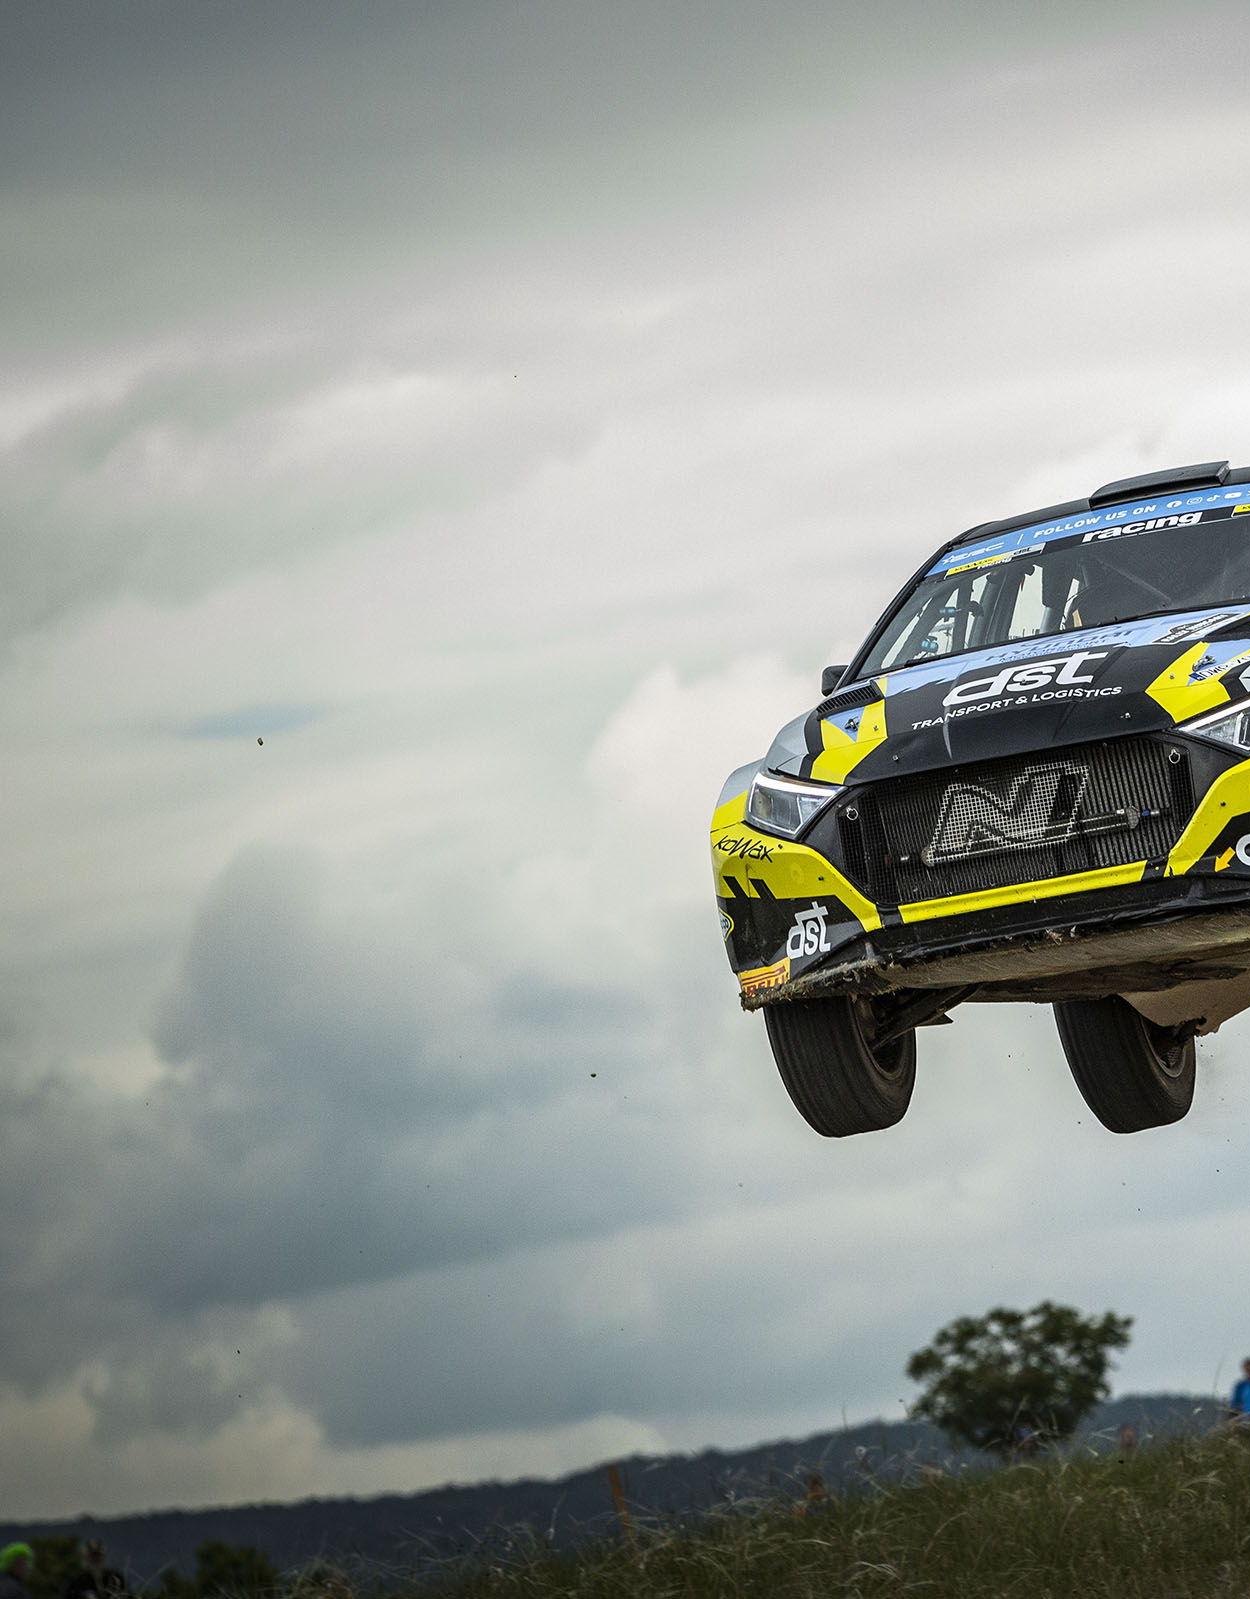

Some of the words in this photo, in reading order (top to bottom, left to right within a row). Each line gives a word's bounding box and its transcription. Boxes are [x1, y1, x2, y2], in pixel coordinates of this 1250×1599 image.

[1033, 515, 1101, 539] FOLLOW
[1105, 509, 1127, 521] US
[1132, 504, 1156, 515] ON
[1081, 511, 1204, 544] racing
[942, 651, 1109, 707] dst
[911, 698, 1014, 730] TRANSPORT
[1015, 695, 1028, 704] &
[1032, 686, 1123, 703] LOGISTICS
[713, 835, 775, 863] koWax
[786, 901, 831, 959] dst
